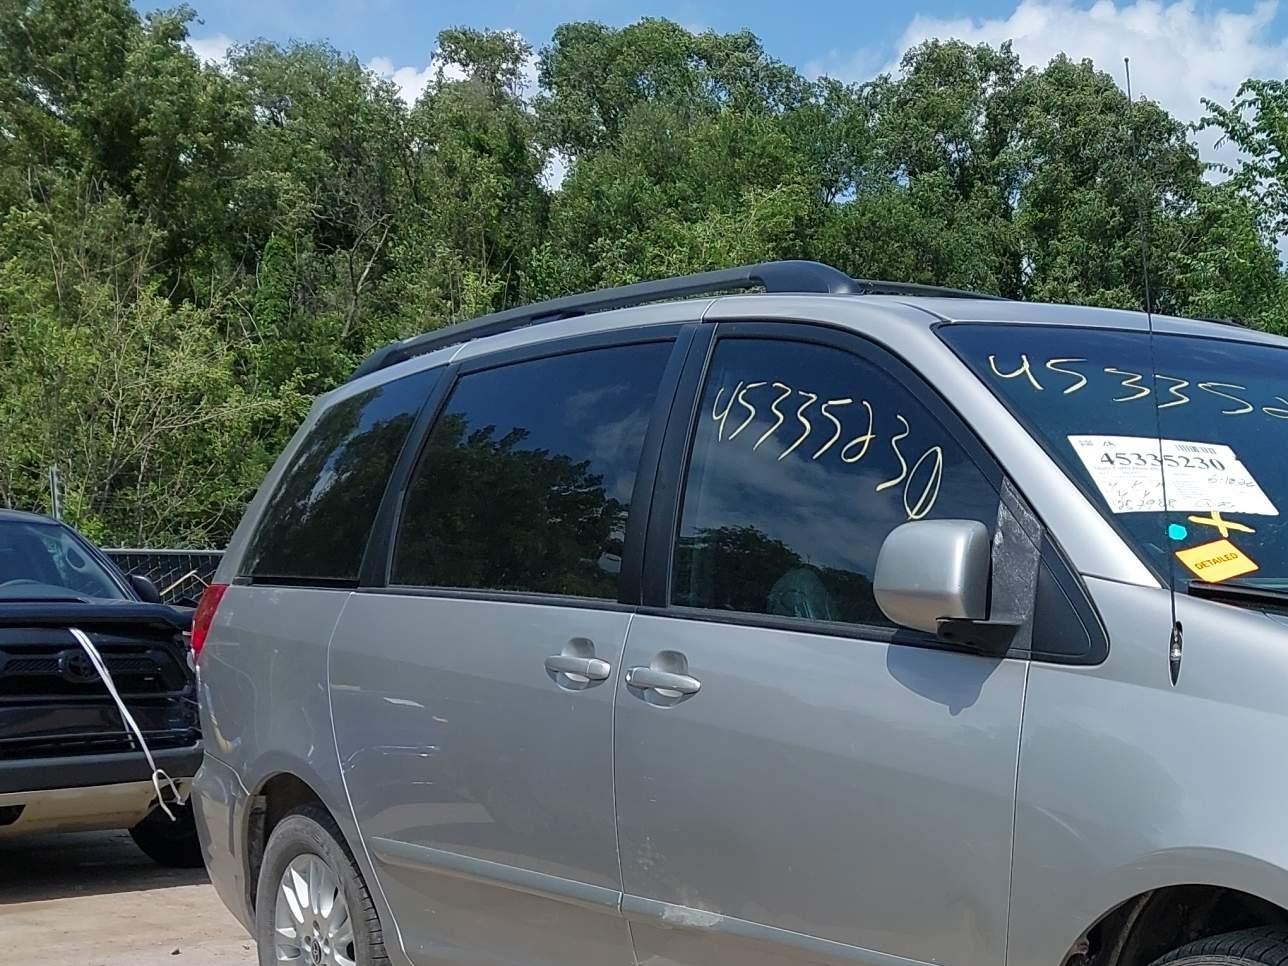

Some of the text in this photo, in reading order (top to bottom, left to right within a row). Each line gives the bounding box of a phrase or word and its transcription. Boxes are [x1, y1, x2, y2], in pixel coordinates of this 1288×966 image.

[712, 381, 943, 520] 45335230
[1100, 451, 1226, 472] 45335230
[1194, 552, 1239, 570] DETAILED
